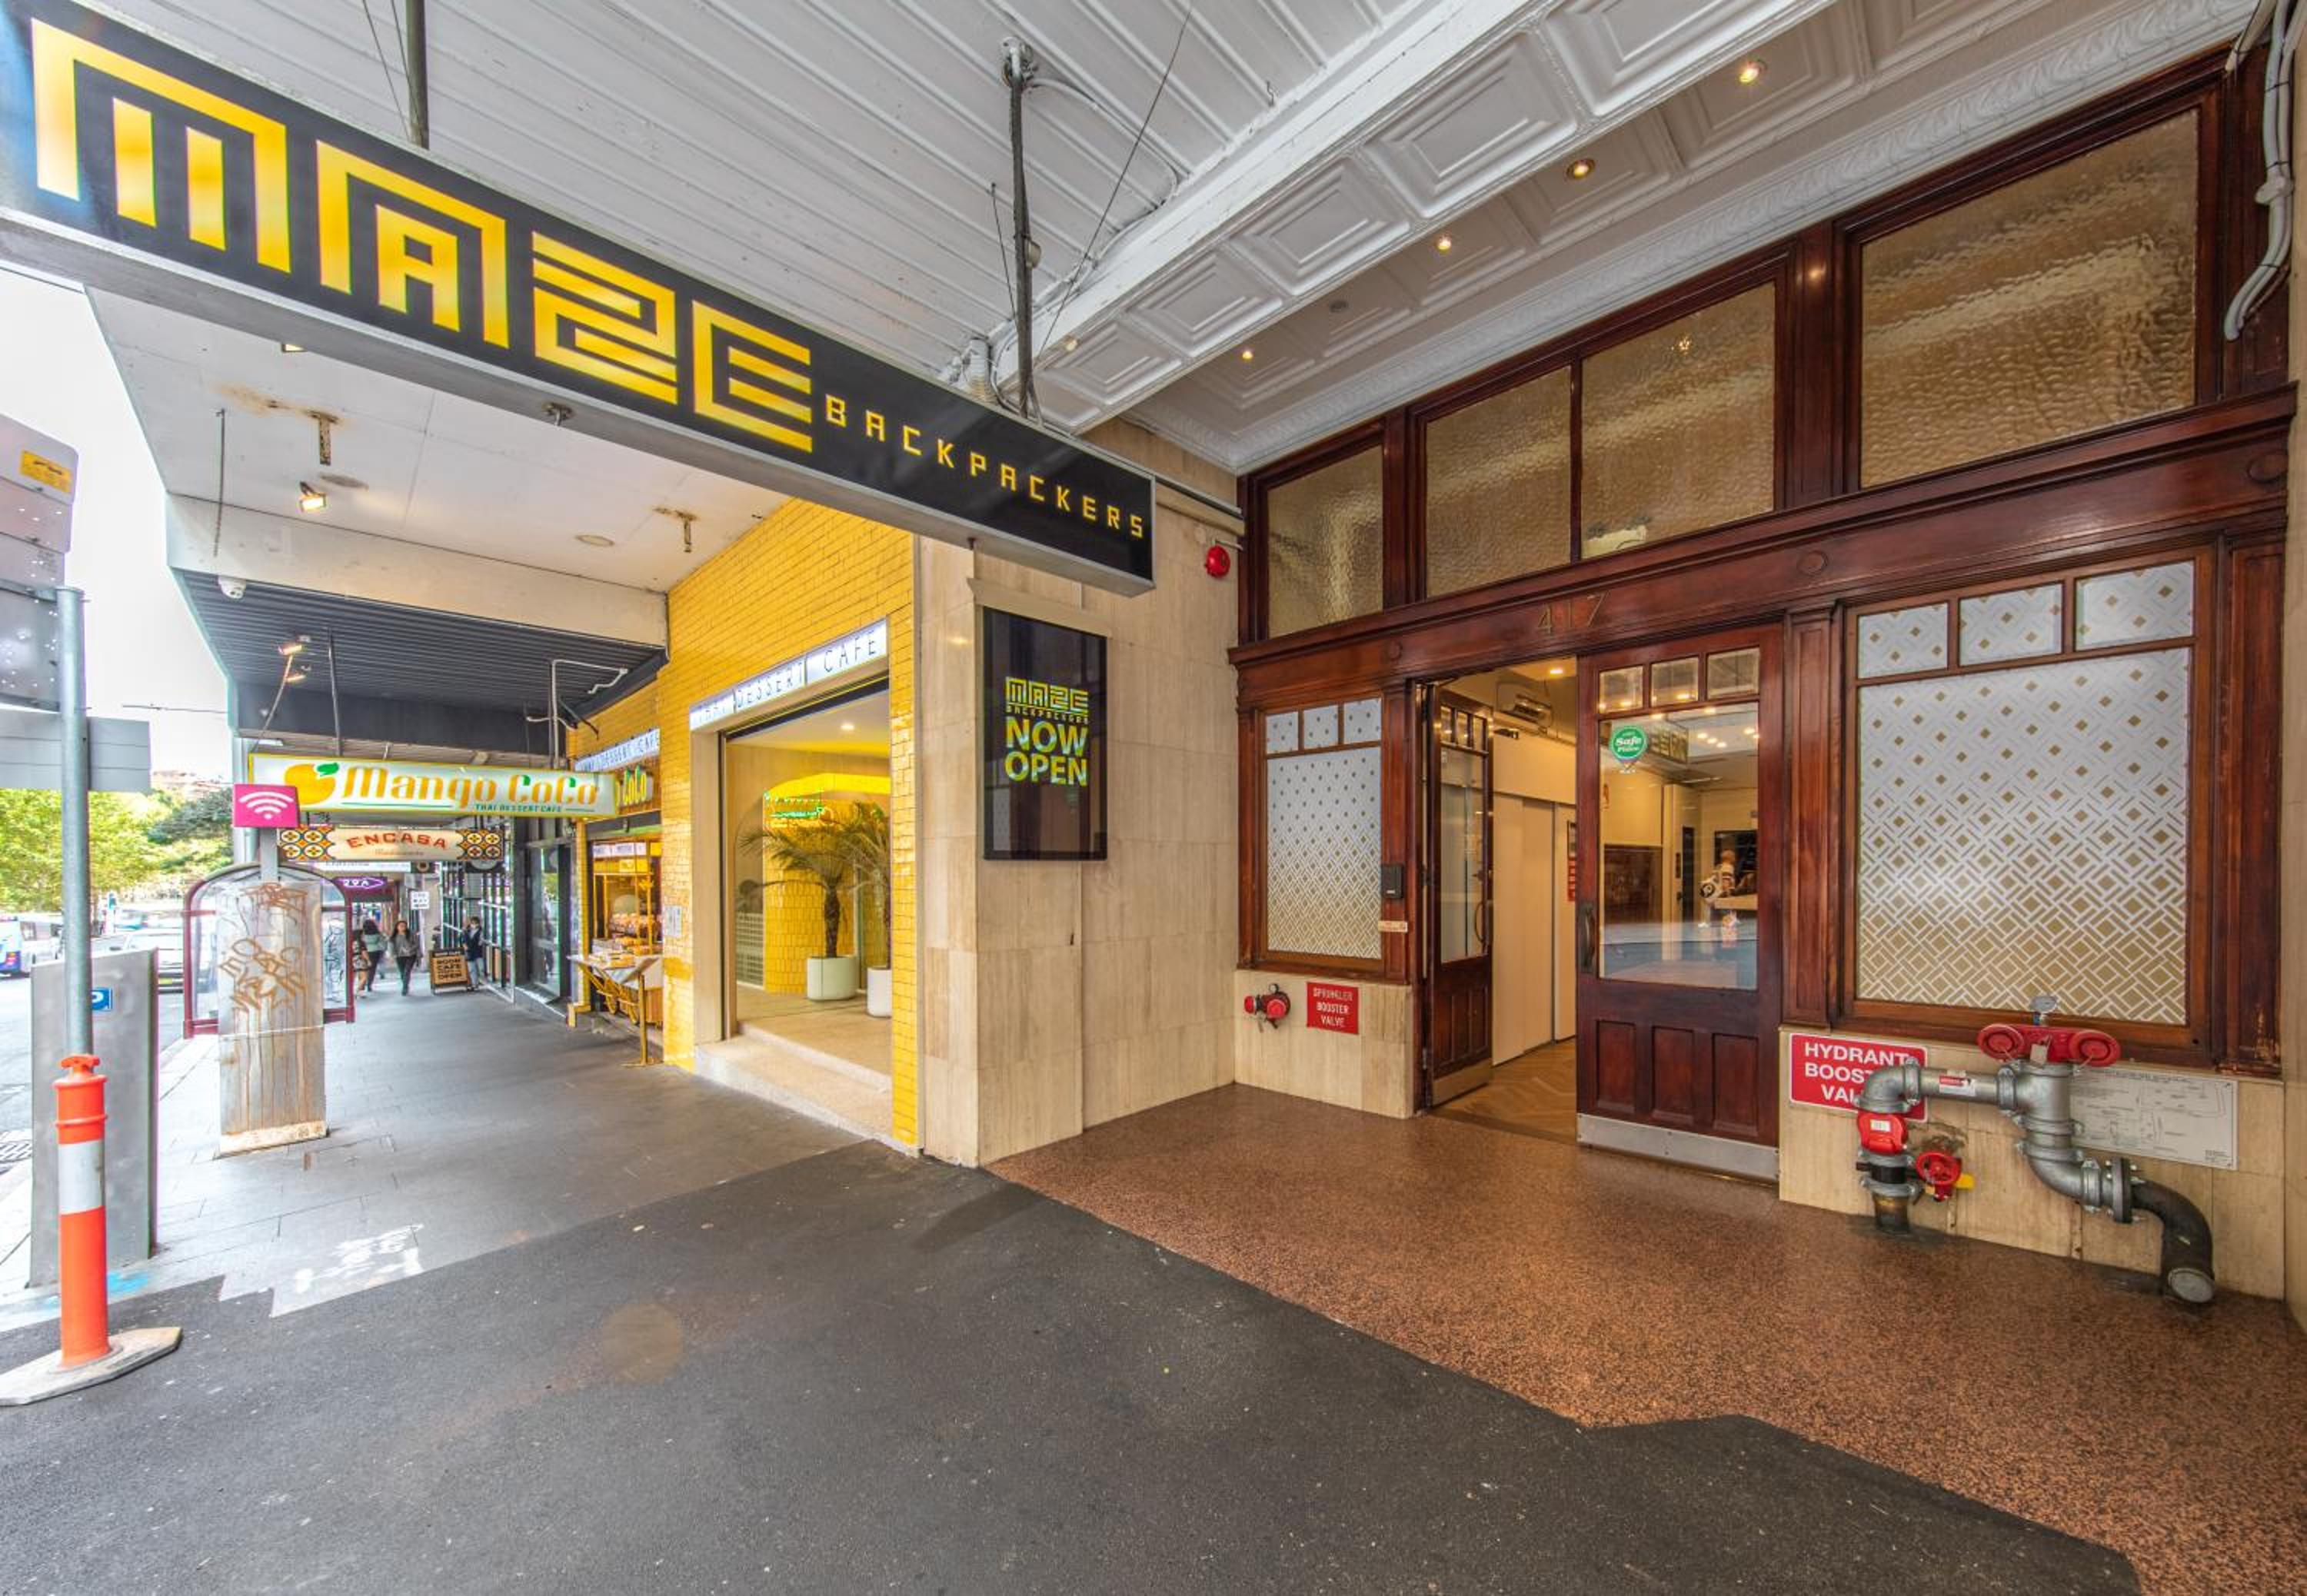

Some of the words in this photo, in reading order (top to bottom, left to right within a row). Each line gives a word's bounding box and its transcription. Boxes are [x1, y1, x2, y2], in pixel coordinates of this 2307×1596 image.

[32, 18, 813, 455] MAZE
[825, 393, 1144, 539] BACKPACKERS
[1539, 590, 1610, 637] 417
[736, 662, 803, 708] DESSERT
[823, 630, 877, 673] CAFE
[1005, 676, 1089, 715] MAZE
[1006, 716, 1088, 757] NOW
[1616, 736, 1642, 746] Safe
[1004, 751, 1087, 786] OPEN
[343, 766, 497, 808] Mango
[346, 833, 448, 850] ENCASA
[1312, 987, 1353, 1001] SPRINKLER
[1316, 1002, 1349, 1013] BOOSTER
[1320, 1016, 1346, 1028] VALVE
[1804, 1042, 1909, 1066] HYDRANT
[1805, 1062, 1873, 1084] BOOS
[1821, 1084, 1857, 1103] VAL
